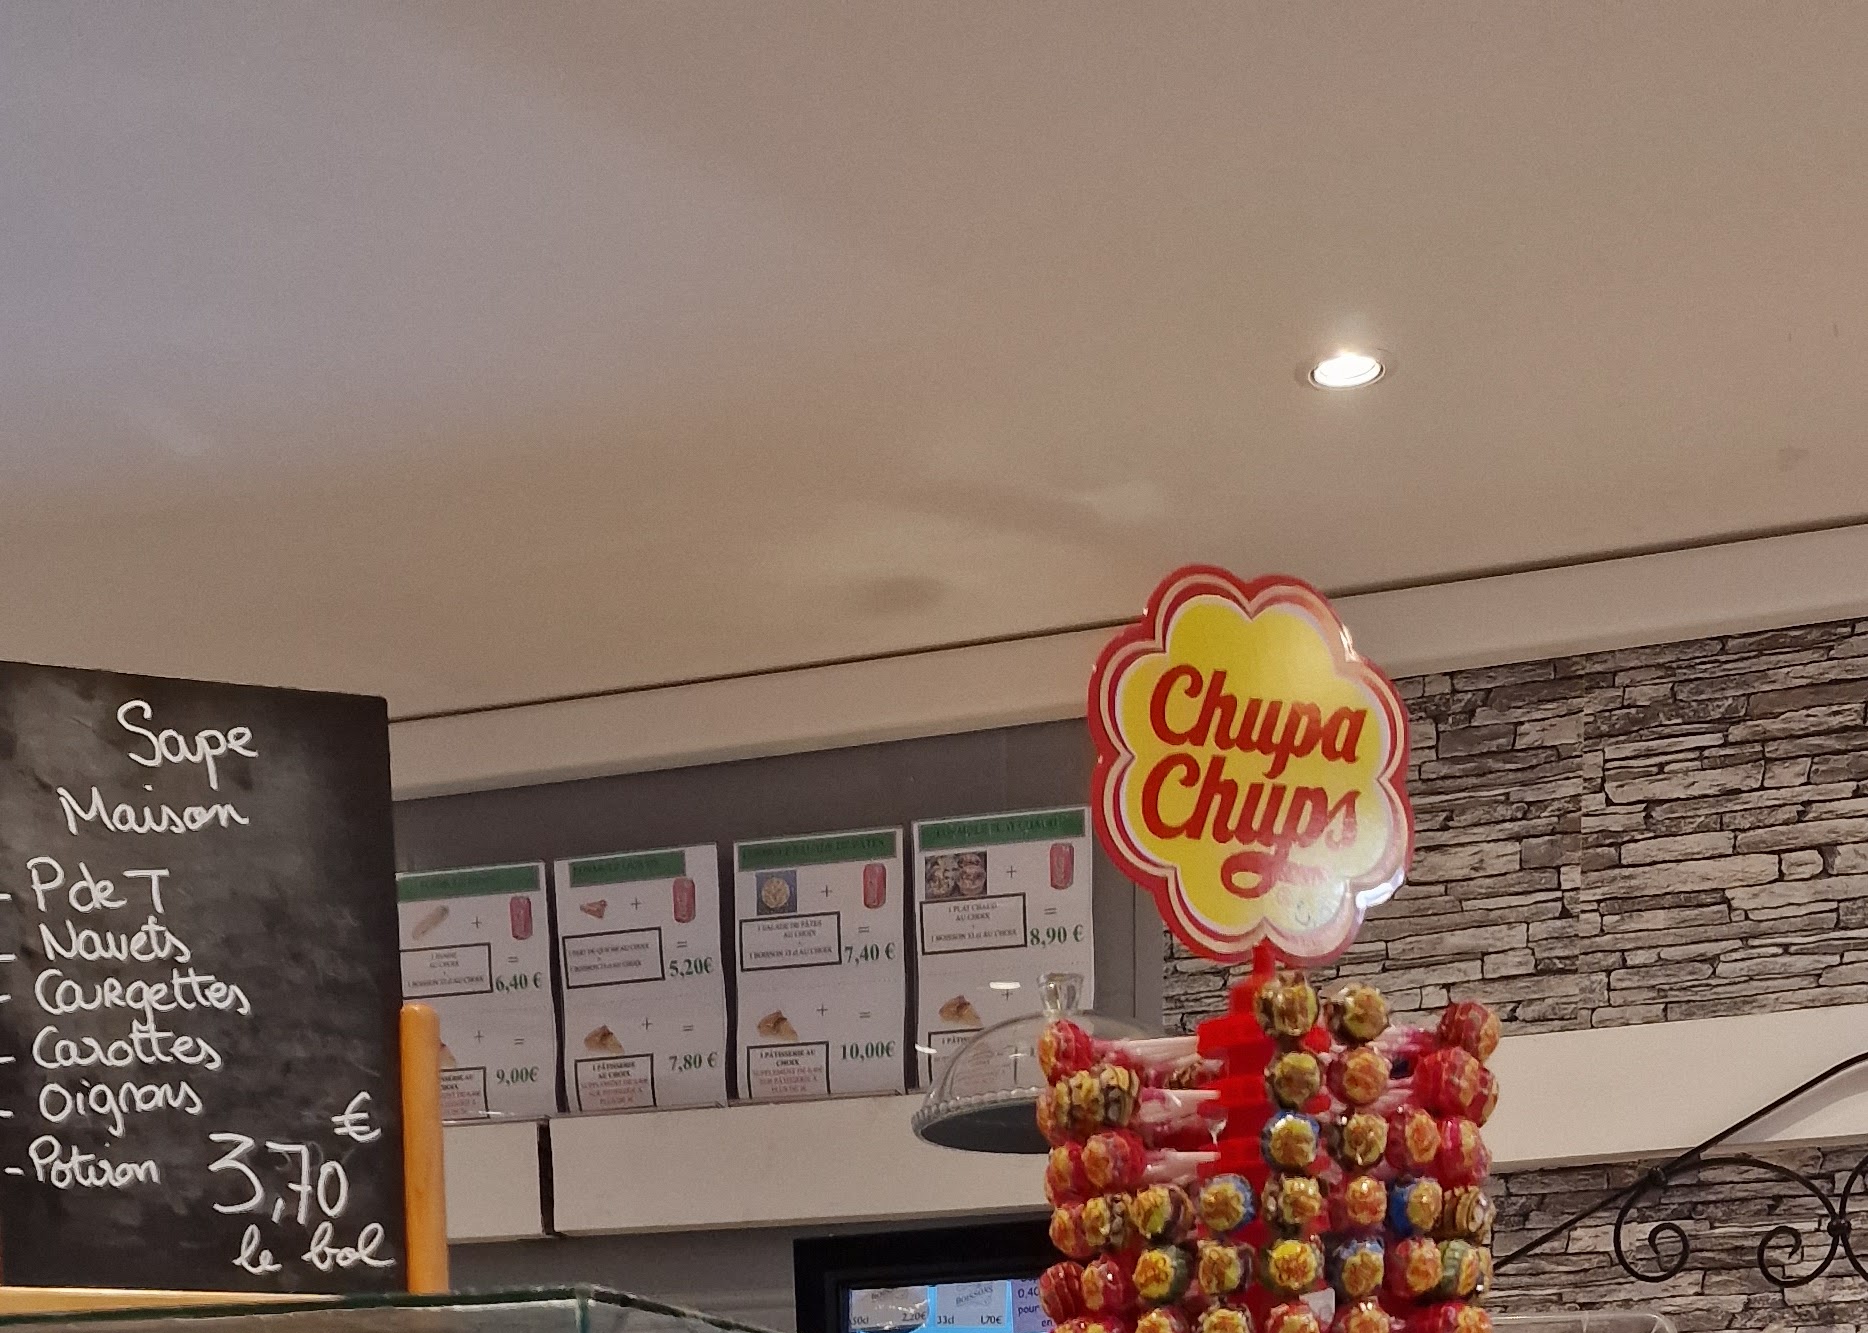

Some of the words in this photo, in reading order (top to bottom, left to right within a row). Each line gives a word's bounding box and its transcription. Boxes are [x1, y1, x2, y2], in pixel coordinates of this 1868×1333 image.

[1150, 665, 1367, 780] Chupa
[57, 785, 250, 836] Maison
[1141, 753, 1362, 899] Chups
[1029, 926, 1067, 948] 8,90
[1073, 924, 1084, 943] €
[844, 944, 880, 965] 7,40
[885, 942, 896, 960] €
[669, 956, 713, 978] 5,20€
[495, 973, 528, 993] 6,40
[668, 1053, 703, 1073] 7,80
[707, 1051, 718, 1067] €
[841, 1040, 896, 1061] 10,00€
[496, 1066, 539, 1085] 9,00€
[38, 1078, 203, 1138] Oignons
[208, 1132, 349, 1224] 3,70
[233, 1223, 282, 1276] le
[301, 1222, 396, 1272] bol
[1017, 1305, 1039, 1317] pour
